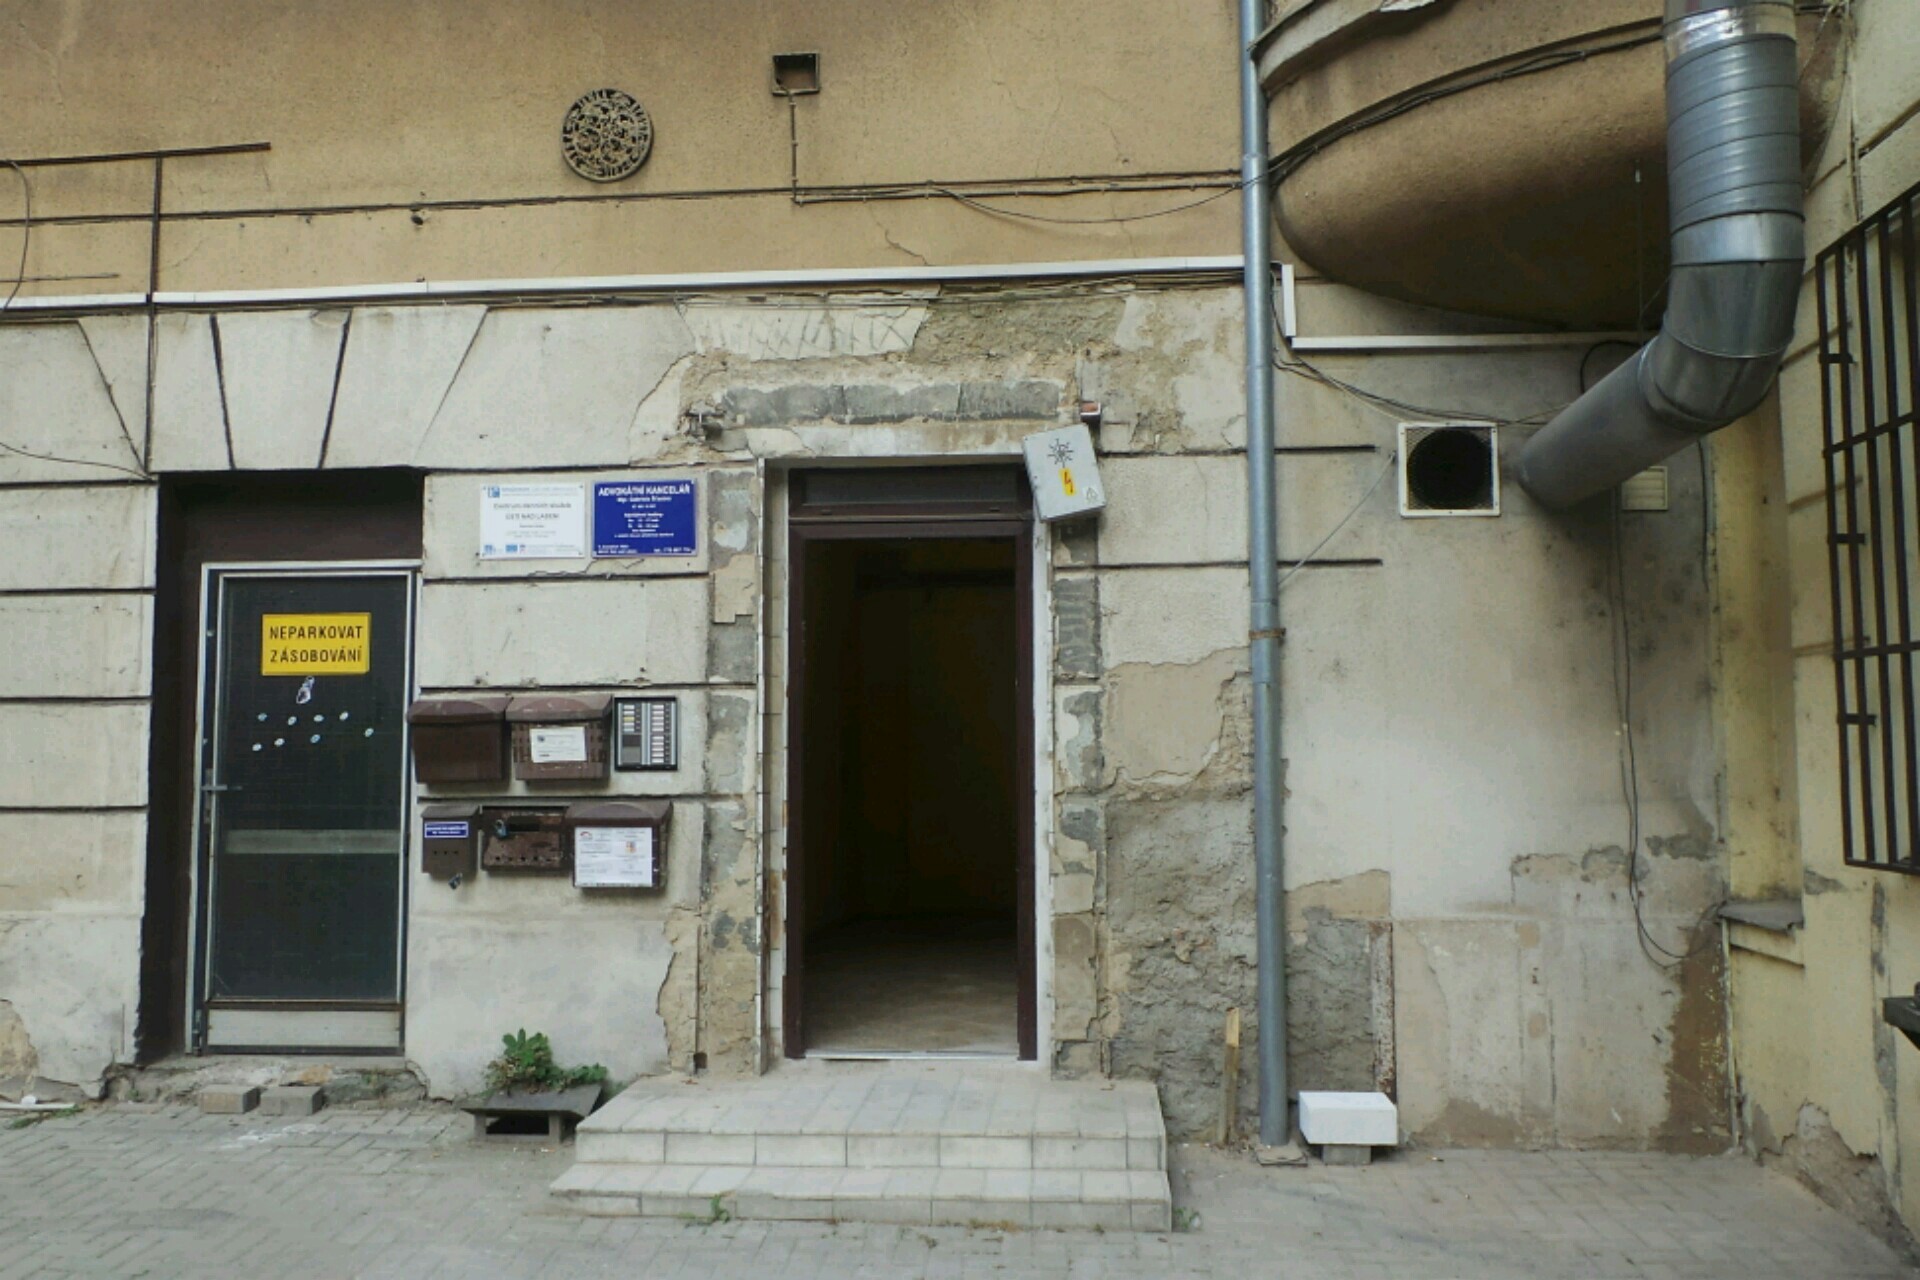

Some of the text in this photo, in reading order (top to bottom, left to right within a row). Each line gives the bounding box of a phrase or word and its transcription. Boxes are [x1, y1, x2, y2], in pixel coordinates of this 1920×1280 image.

[598, 484, 690, 496] ADVOKÁTNÍ KANCELÁŘ
[269, 625, 363, 640] NEPARKOVAT
[269, 646, 362, 662] ZÁSOBOVÁNÍ
